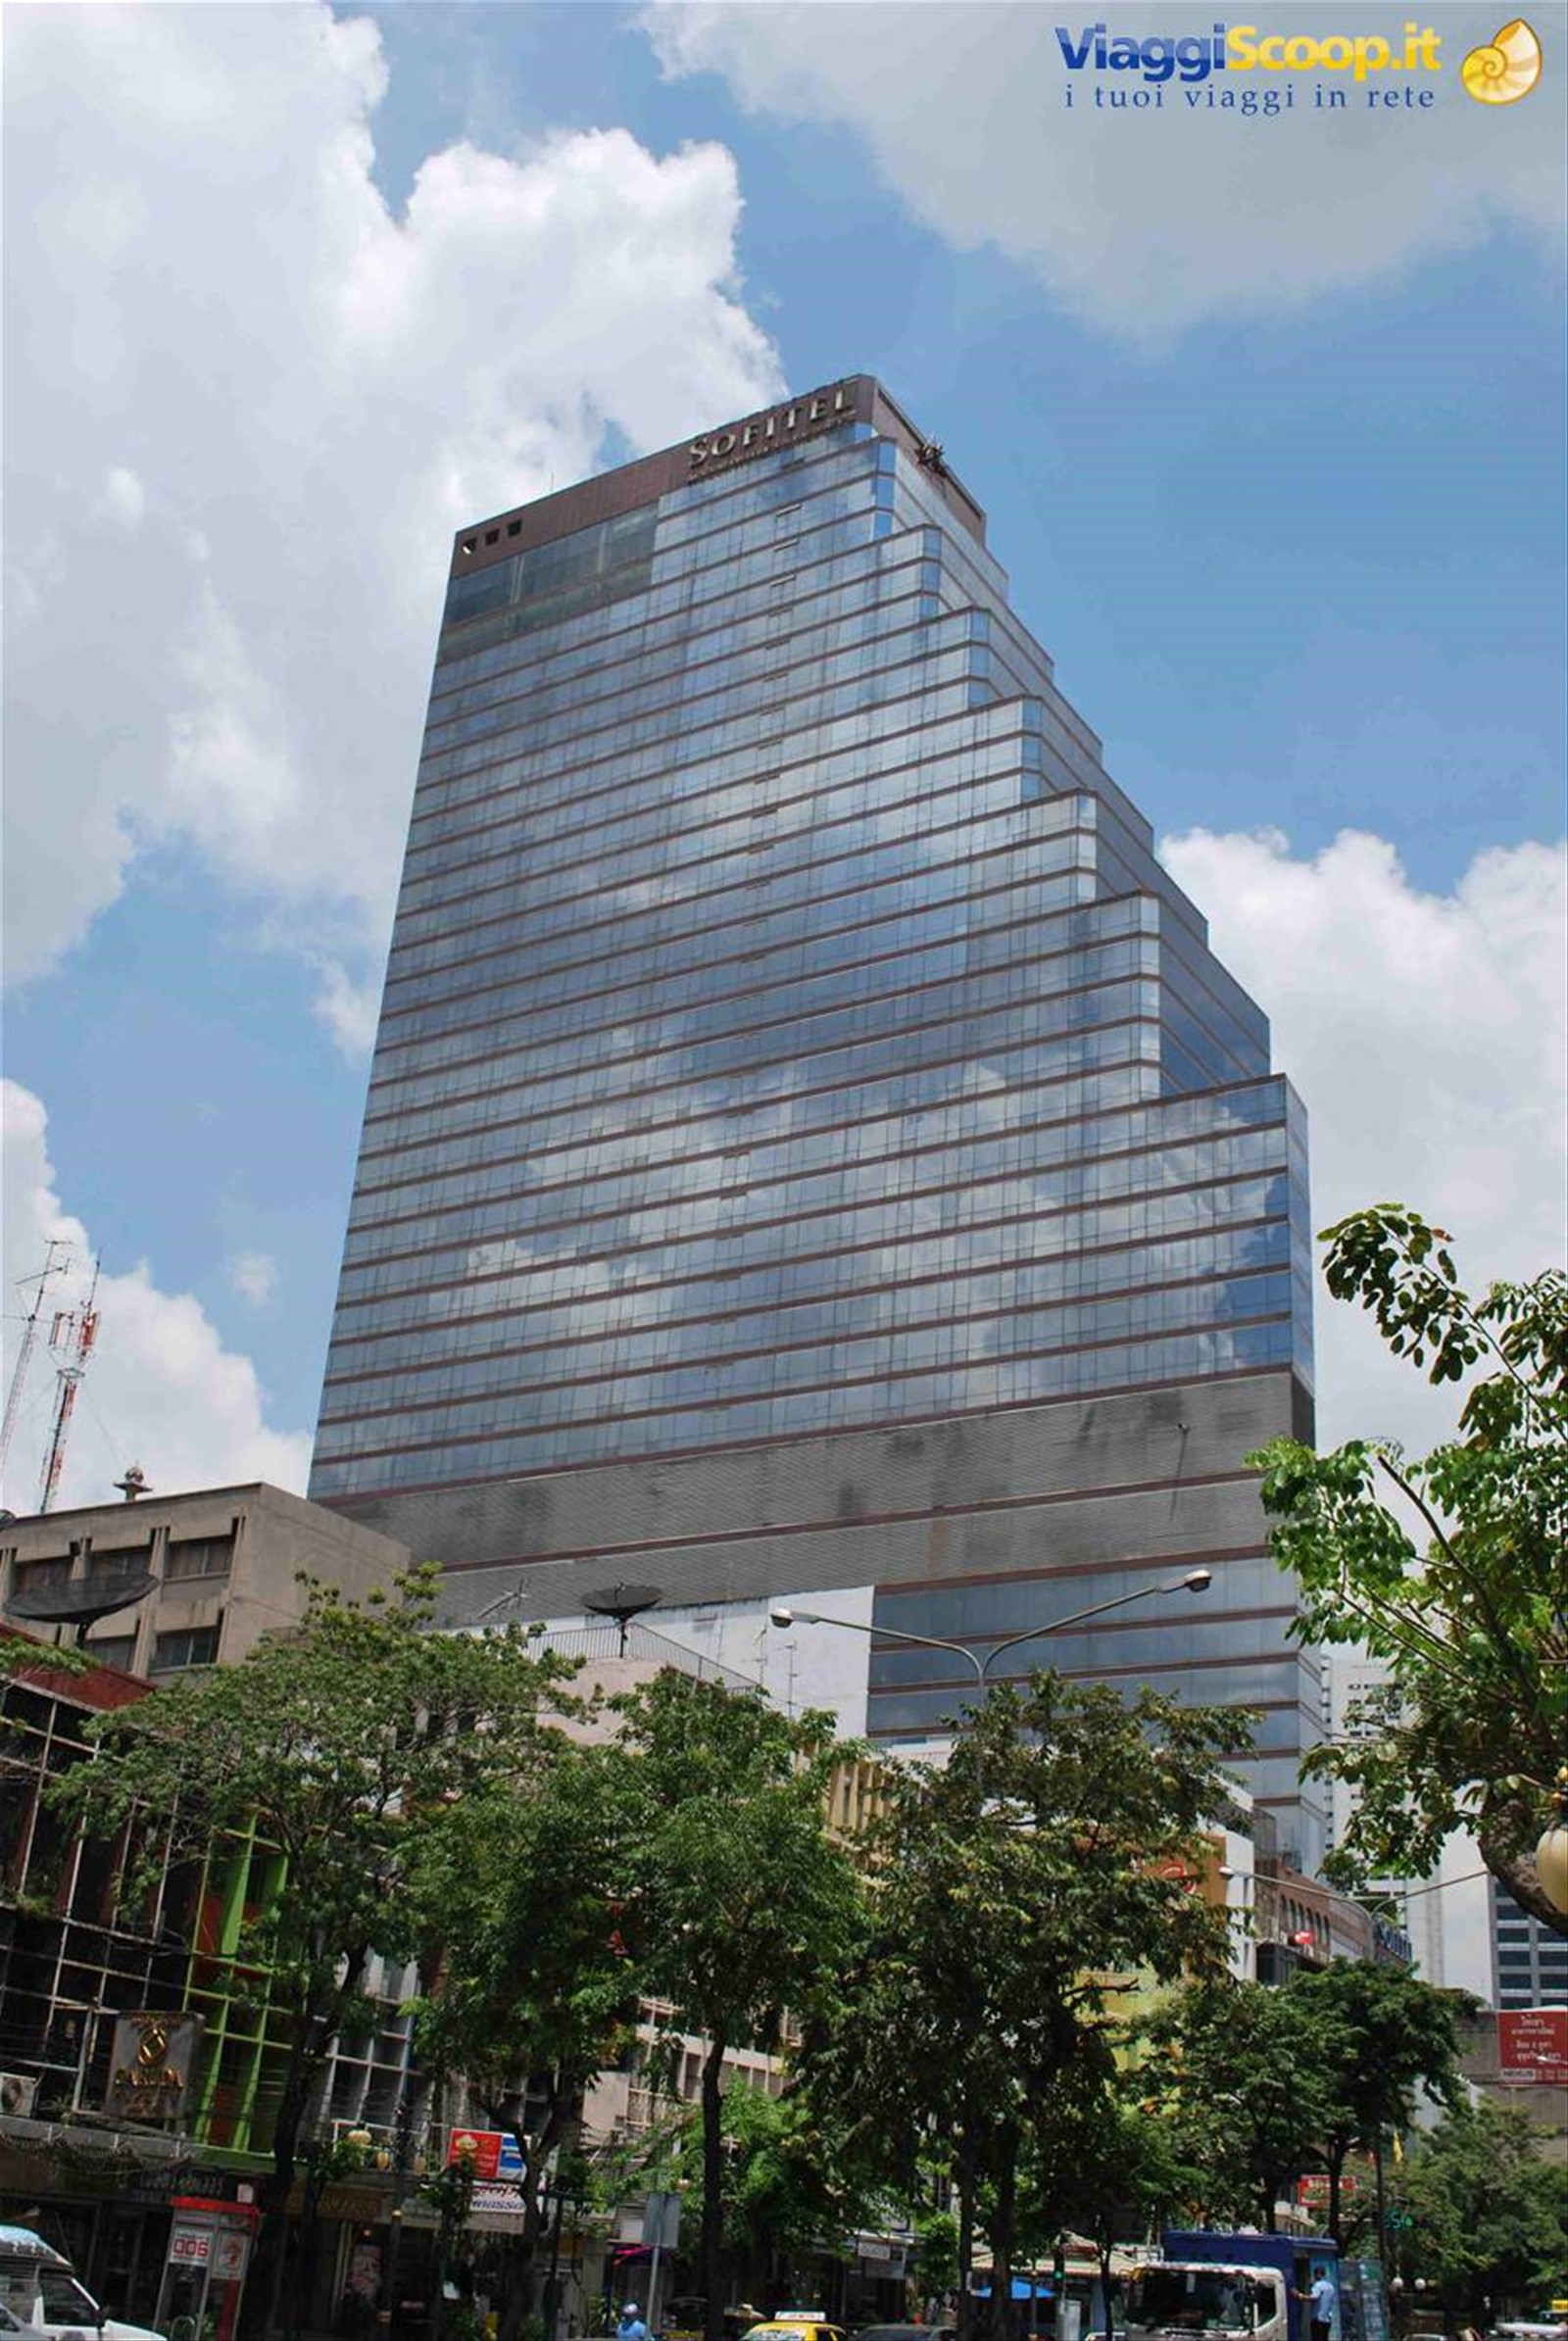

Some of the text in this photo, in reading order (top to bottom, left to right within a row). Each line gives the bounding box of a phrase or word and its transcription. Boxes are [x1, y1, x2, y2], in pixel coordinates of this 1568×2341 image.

[688, 389, 853, 468] SOFITEL
[472, 2199, 526, 2212] massa
[173, 2239, 210, 2258] 006
